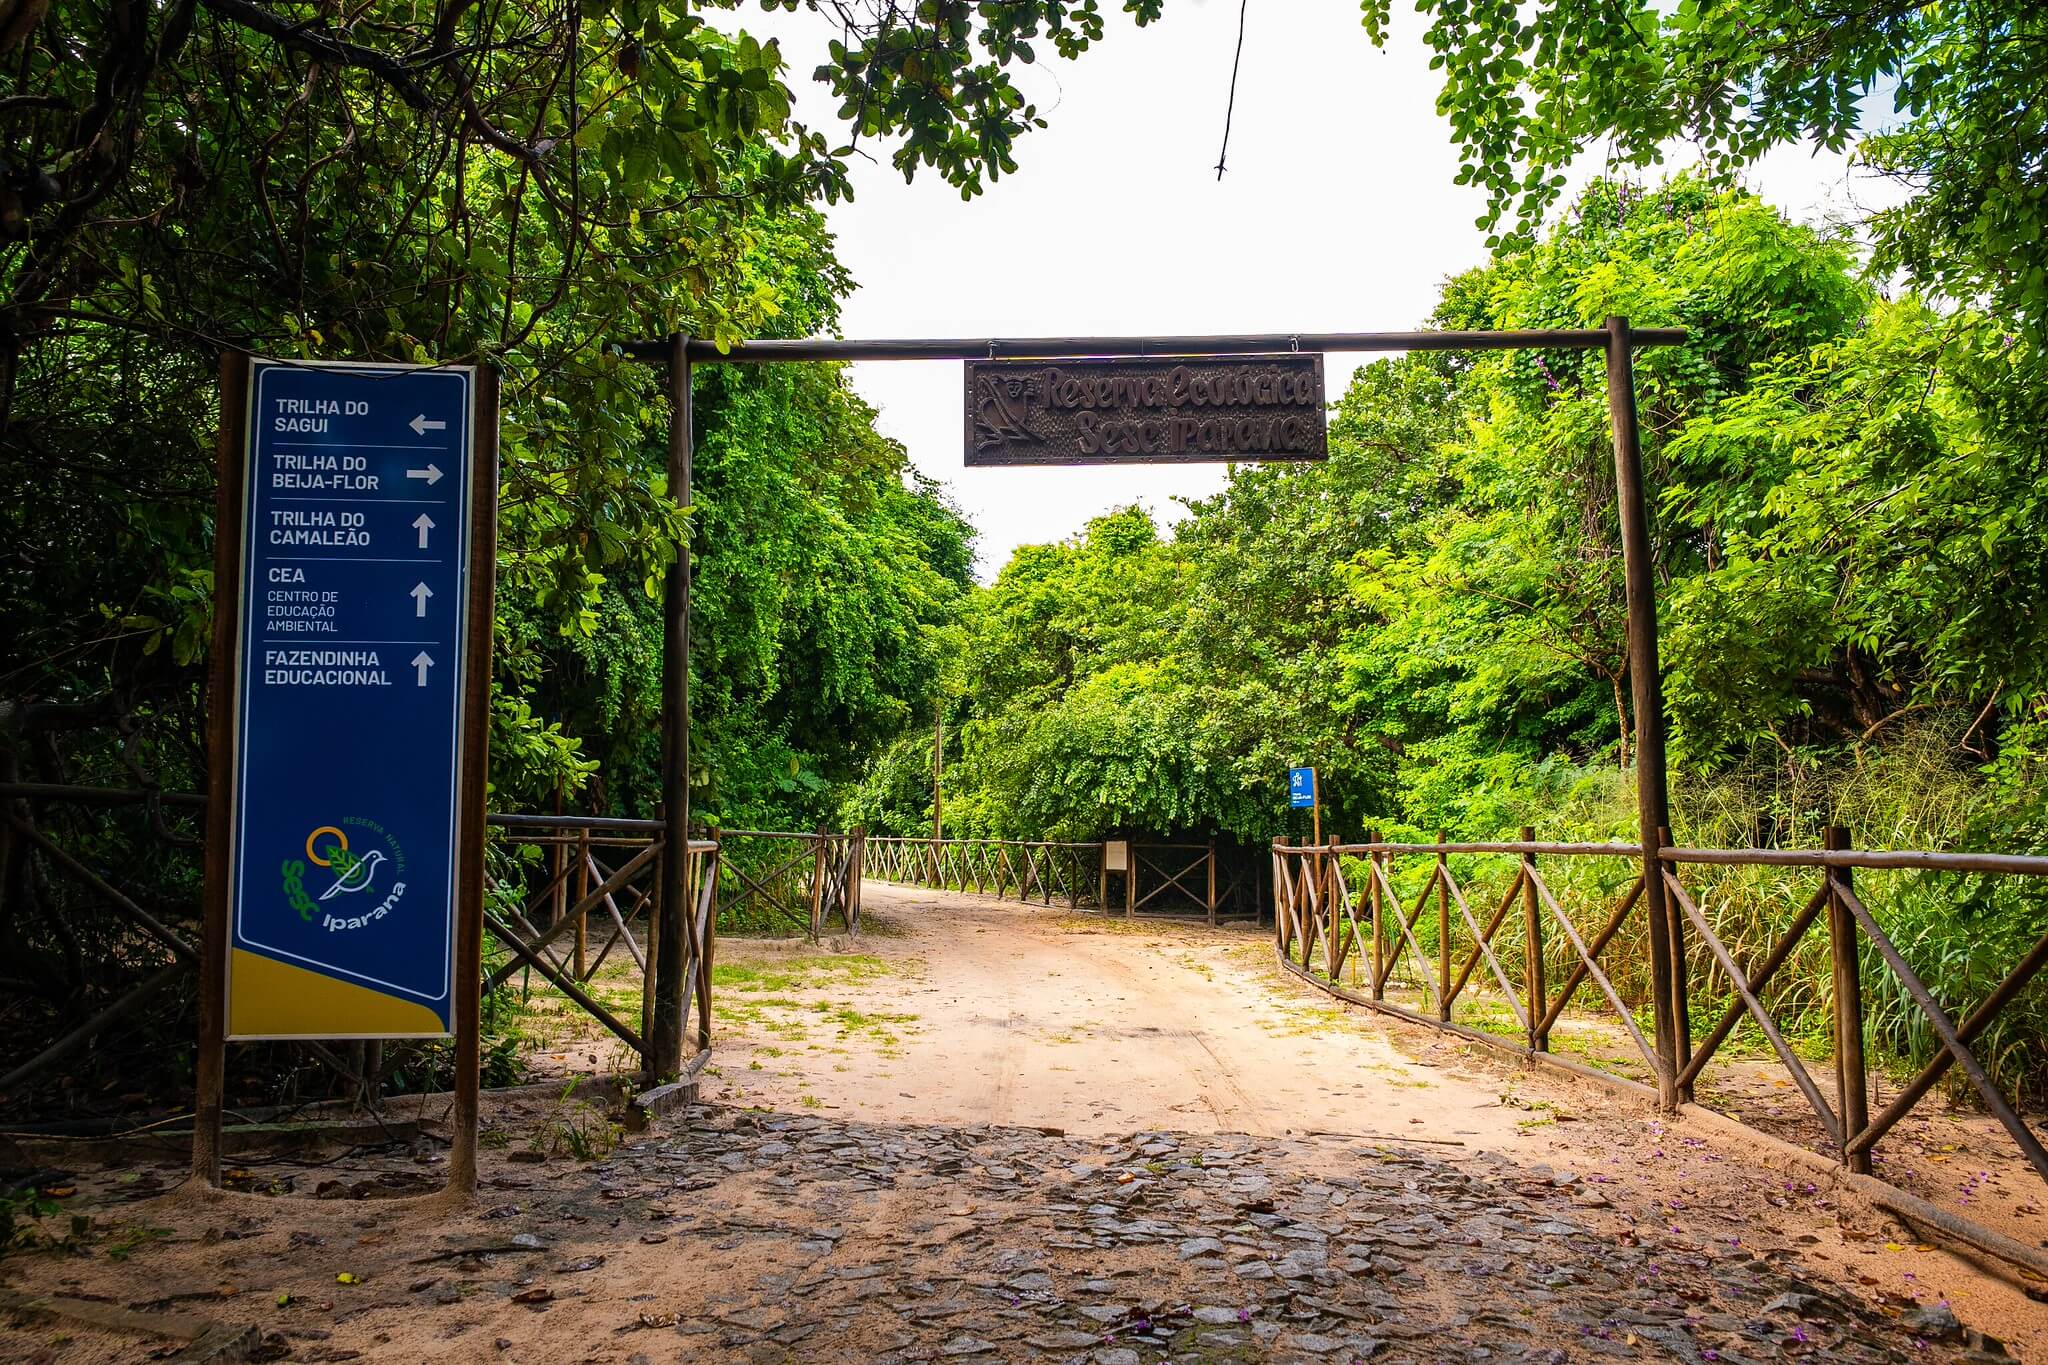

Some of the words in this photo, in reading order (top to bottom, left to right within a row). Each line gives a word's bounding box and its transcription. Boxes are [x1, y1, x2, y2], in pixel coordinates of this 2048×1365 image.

[1041, 366, 1164, 409] Reserva
[275, 398, 341, 415] TRILHA
[344, 400, 369, 416] DO
[274, 417, 329, 433] SAGUI
[1075, 410, 1161, 454] Sesc
[273, 454, 338, 471] TRILHA
[342, 456, 367, 471] DO
[272, 473, 379, 491] BEIJA-FLOR
[270, 510, 336, 527] TRILHA
[340, 512, 365, 528] DO
[270, 528, 371, 546] CAMALEÃO
[268, 567, 306, 583] CEA
[267, 590, 319, 603] CENTRO
[321, 591, 339, 603] DE
[267, 603, 335, 618] EDUCAÇÃO
[266, 620, 339, 632] AMBIENTAL
[265, 650, 380, 667] FAZENDINHA
[264, 669, 393, 686] EDUCACIONAL
[342, 816, 384, 833] RESERVA
[281, 859, 321, 922] Sesc
[322, 881, 407, 933] Iparana
